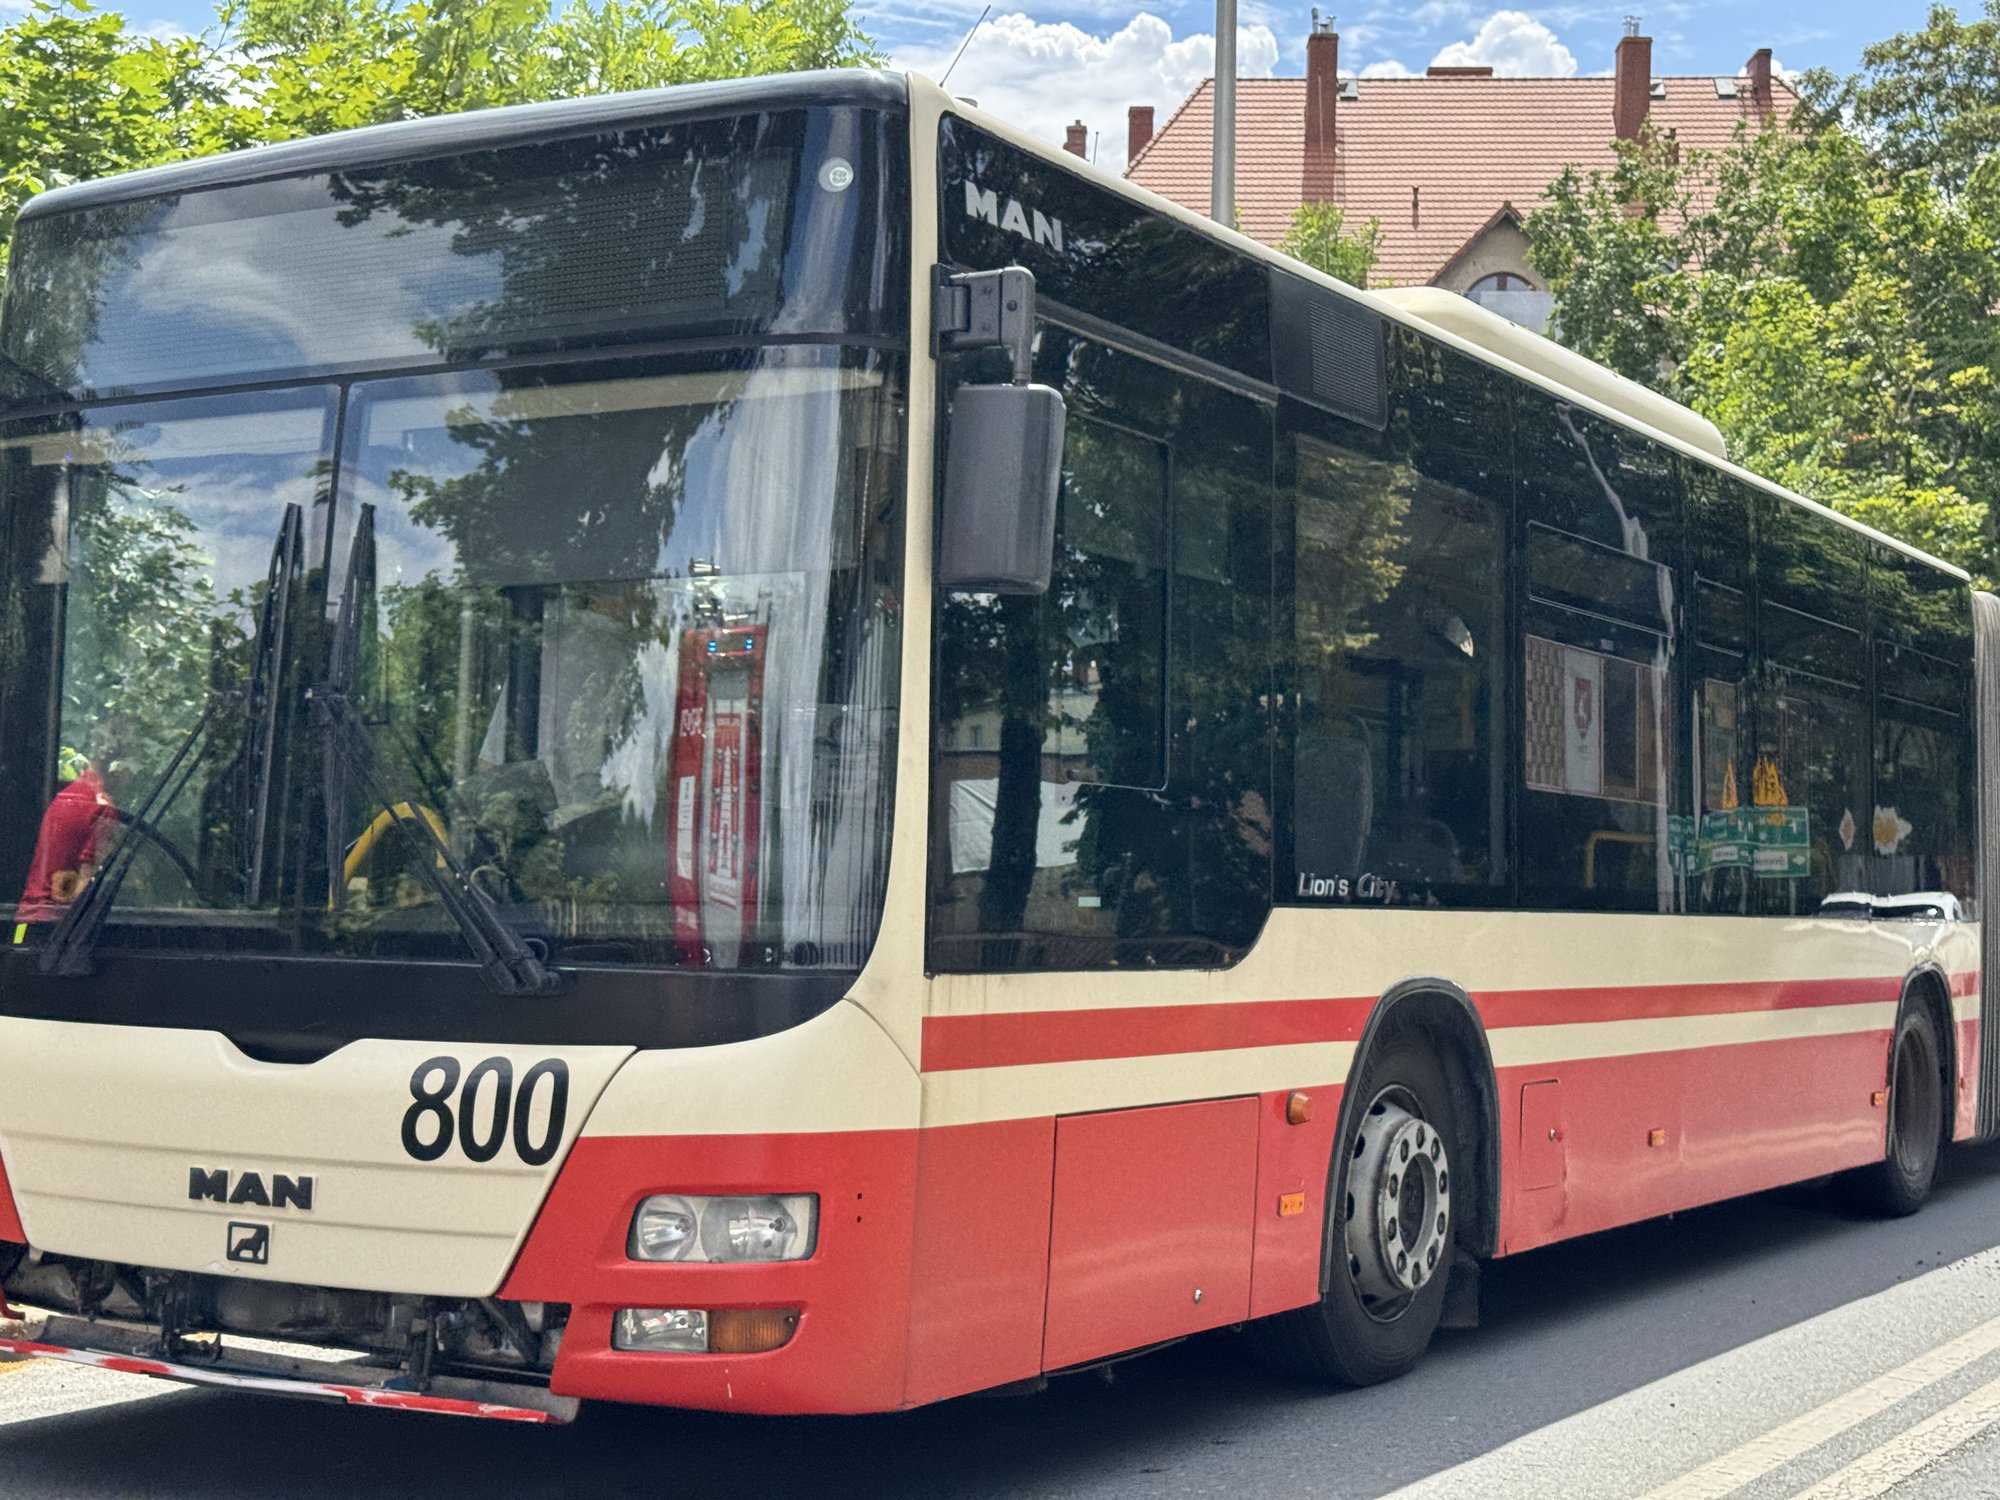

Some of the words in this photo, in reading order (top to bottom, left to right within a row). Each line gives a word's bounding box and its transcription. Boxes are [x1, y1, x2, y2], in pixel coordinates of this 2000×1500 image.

[965, 180, 1063, 252] MAN
[1298, 872, 1349, 897] Lion's
[1357, 872, 1397, 904] City
[401, 1056, 569, 1166] 800
[189, 1167, 313, 1210] MAN
